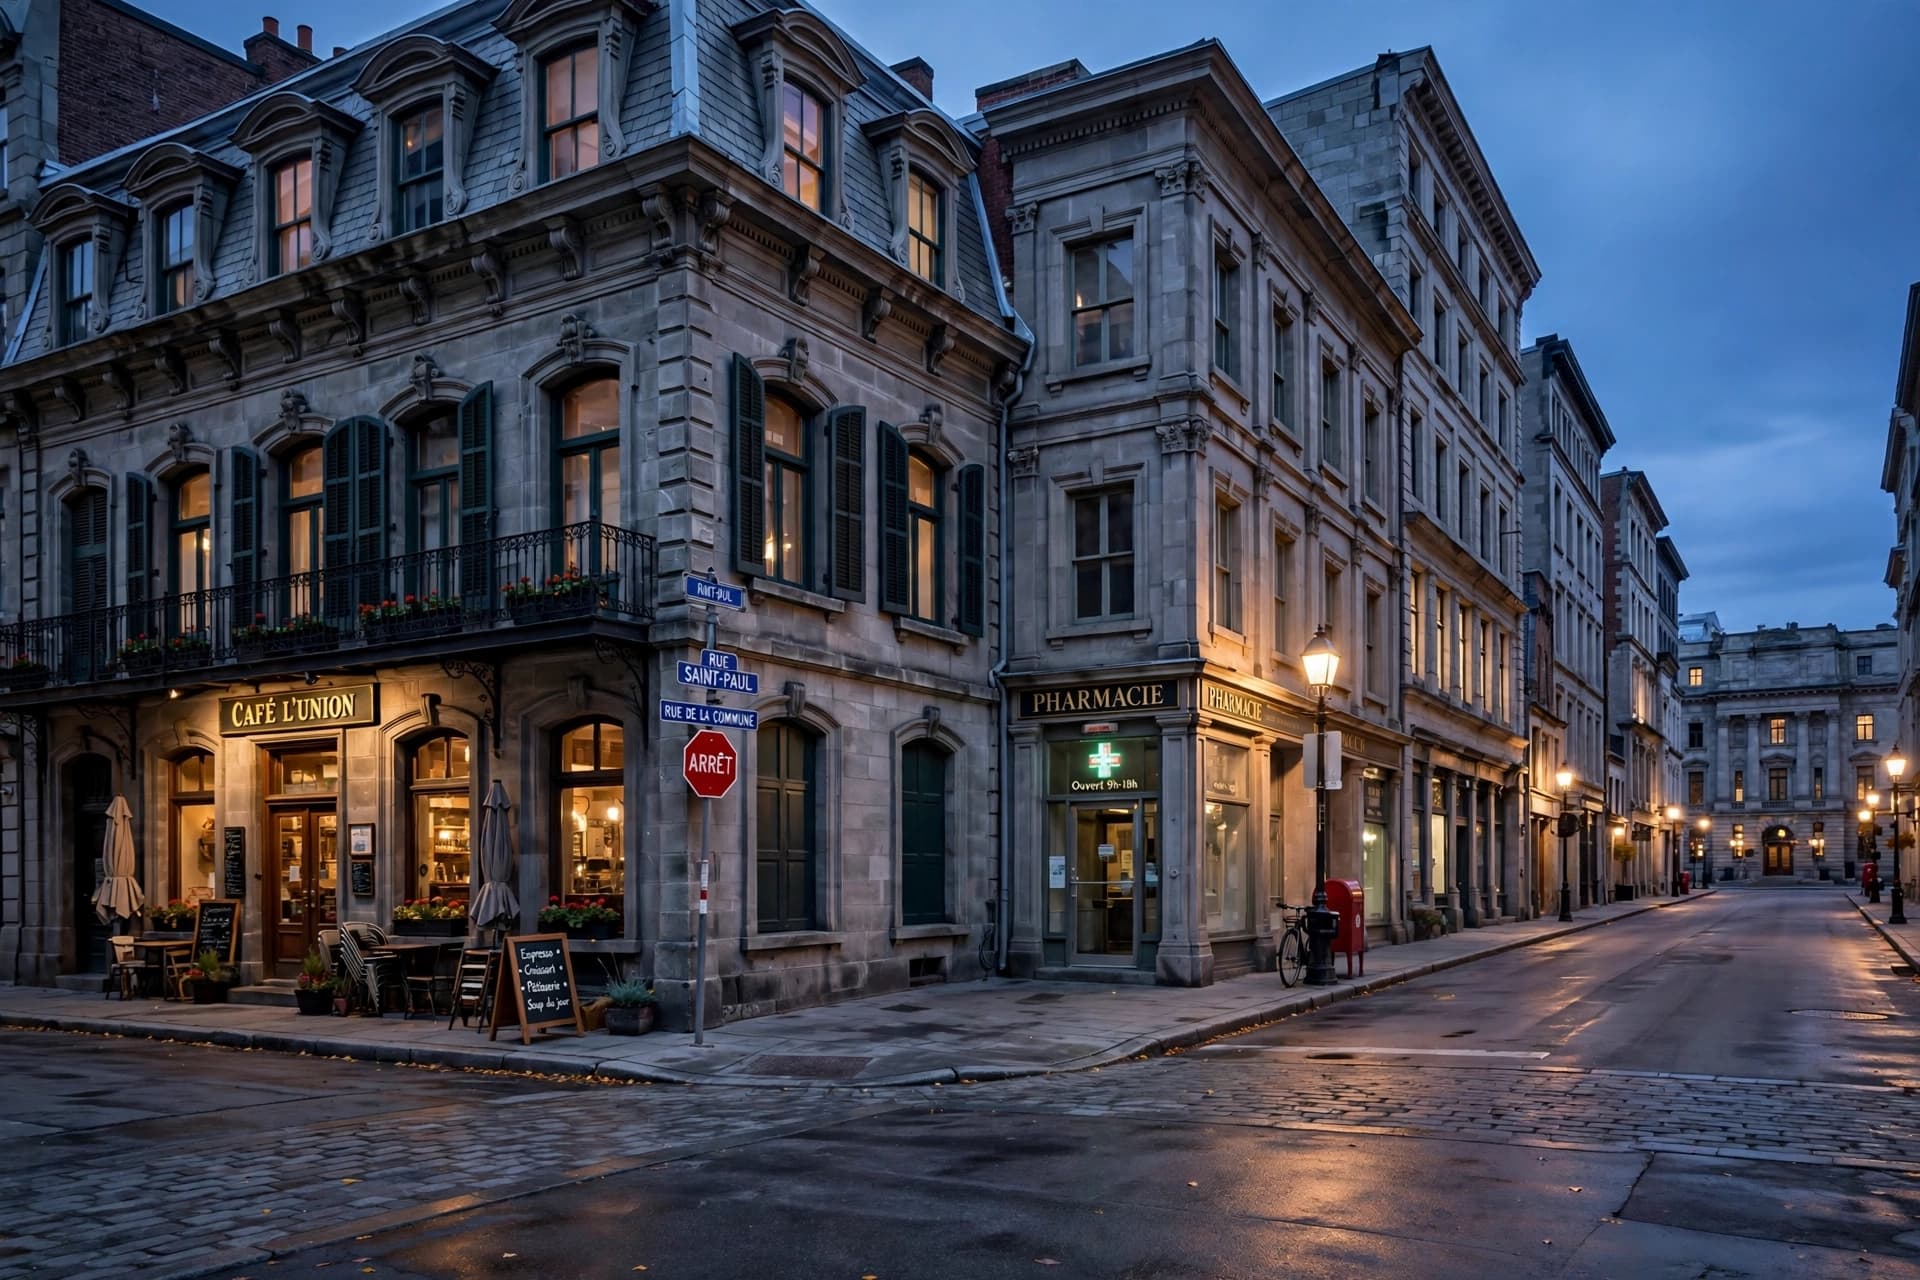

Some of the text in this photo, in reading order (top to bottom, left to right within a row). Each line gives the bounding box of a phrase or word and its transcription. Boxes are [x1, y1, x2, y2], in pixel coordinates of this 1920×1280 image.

[709, 653, 729, 669] RUE
[685, 666, 753, 691] SAINT-PAUL
[232, 693, 356, 728] CAFÉ L'UNION
[1032, 684, 1164, 713] PHARMACIE
[1208, 687, 1262, 721] PHARMACIE
[664, 704, 755, 727] RUE DE LA COMMUNE
[689, 753, 733, 776] ARRÊT
[1071, 780, 1104, 791] Ouvert
